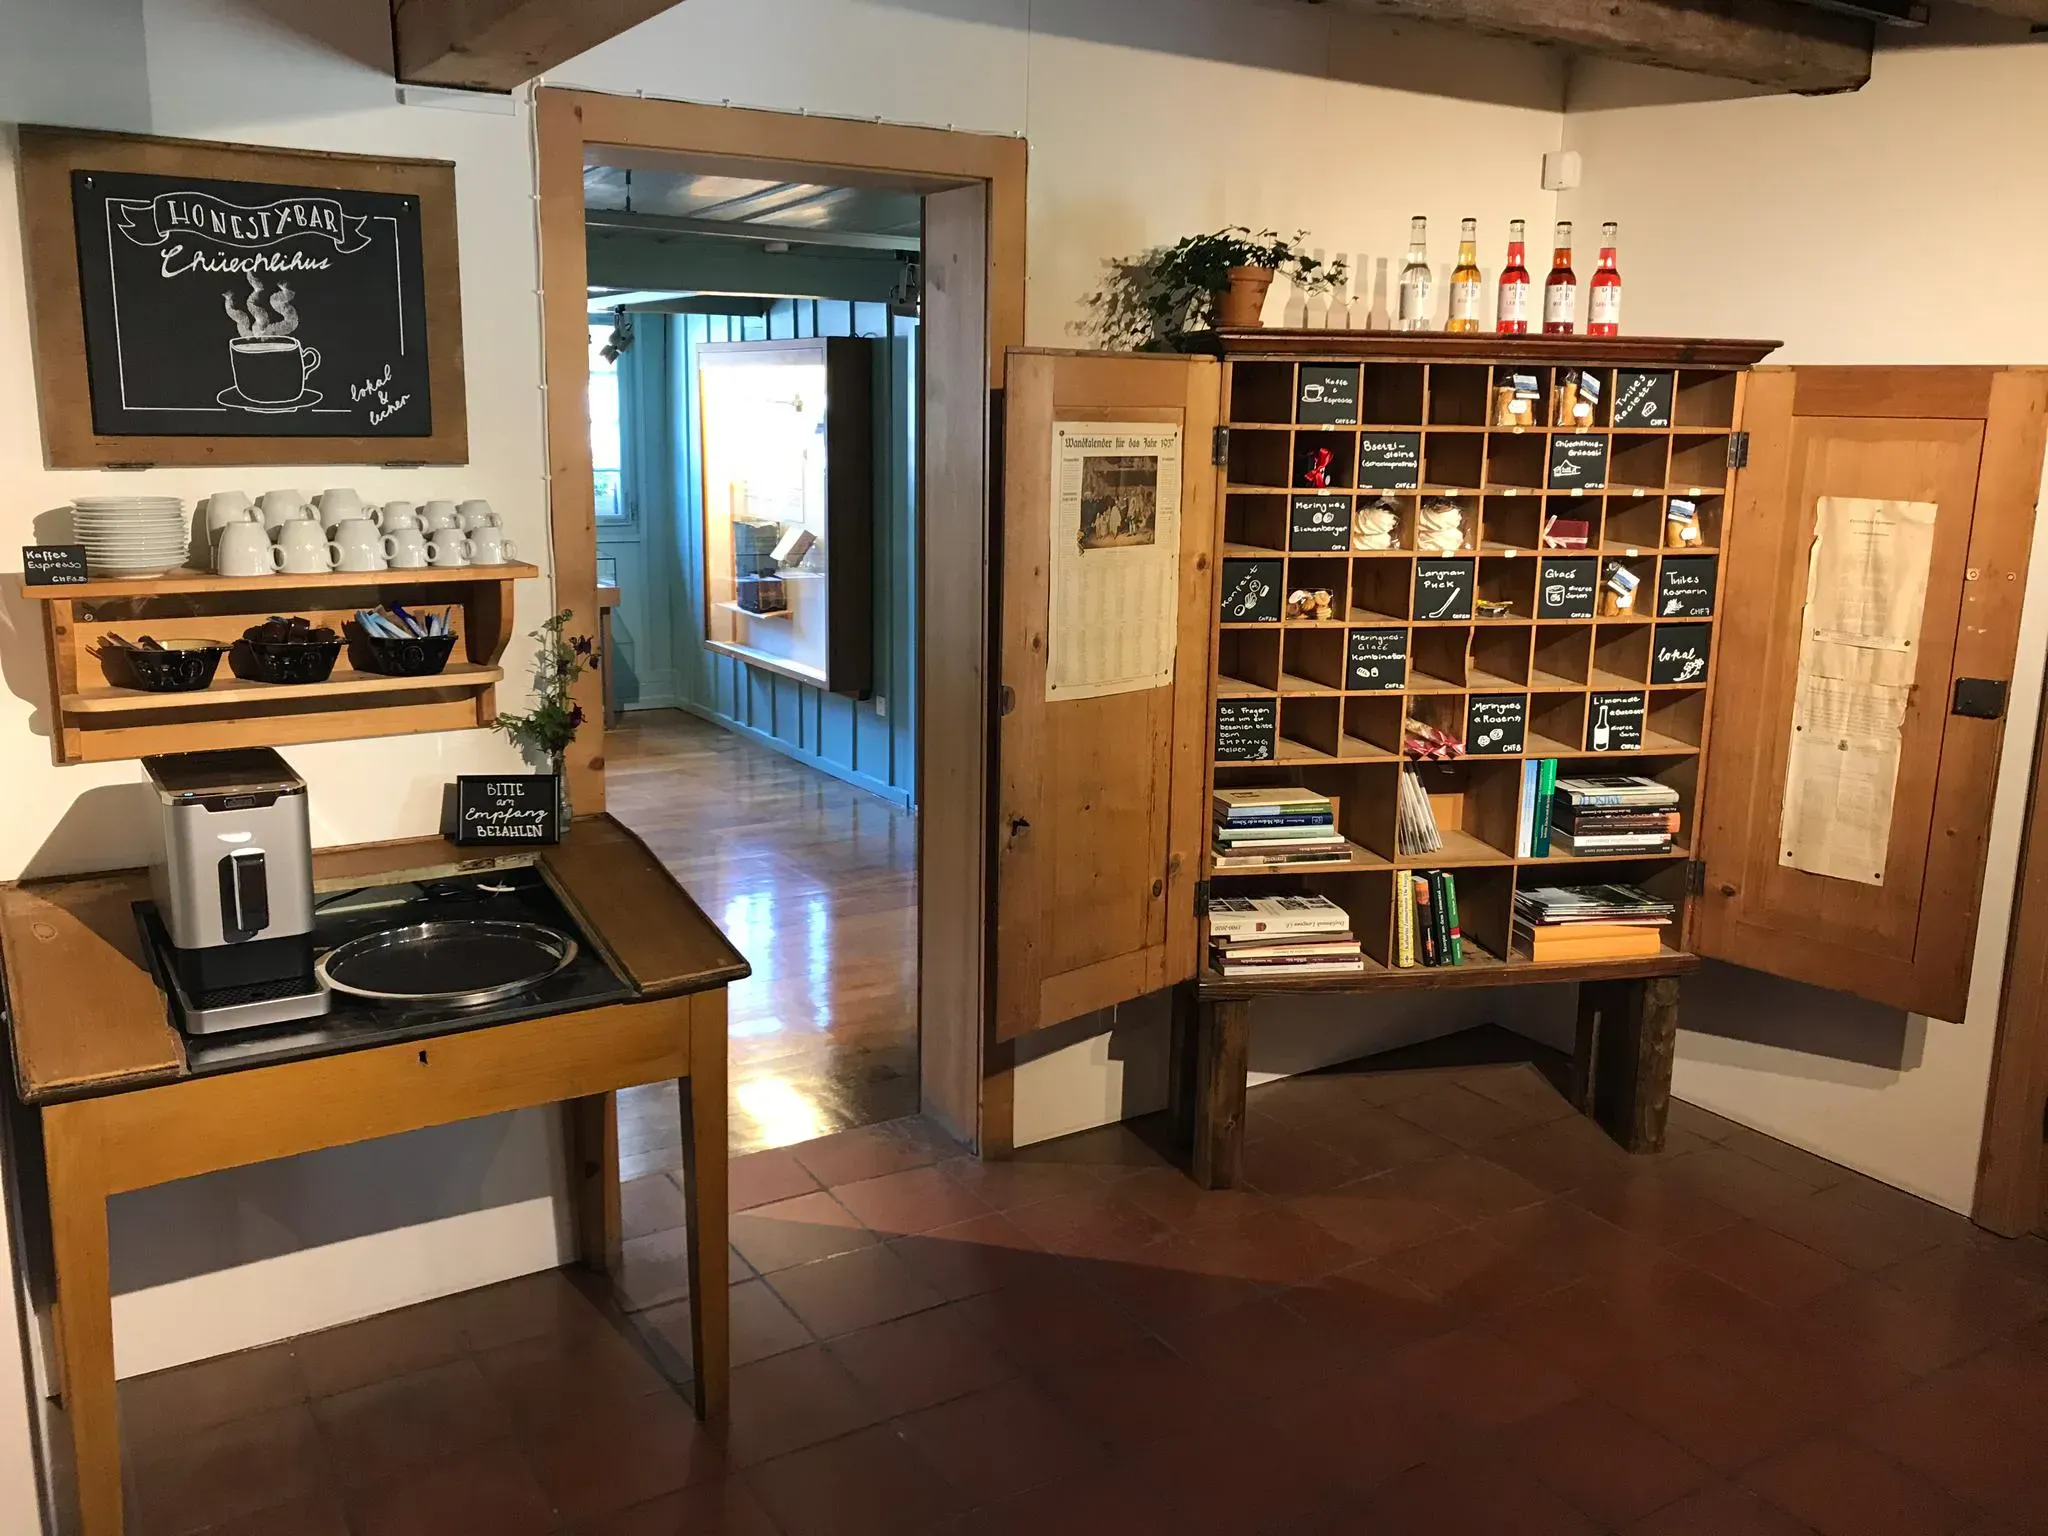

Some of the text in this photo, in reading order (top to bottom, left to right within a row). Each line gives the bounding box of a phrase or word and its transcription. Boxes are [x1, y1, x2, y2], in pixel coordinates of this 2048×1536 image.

[161, 244, 332, 278] Chüechlihus
[1614, 377, 1657, 423] Raclette
[1065, 437, 1112, 448] Wandkalender
[1115, 437, 1125, 449] für
[1128, 437, 1139, 448] das
[1143, 437, 1157, 448] Jahr
[25, 550, 68, 561] Kaffee
[1665, 571, 1700, 585] Tuiles
[1663, 588, 1708, 596] Rosmarin
[1593, 696, 1641, 705] Limonade
[1220, 707, 1270, 718] Bei Fragen
[487, 783, 525, 796] BITTE
[465, 807, 549, 824] Empfang
[476, 824, 544, 838] BEZAHLEN
